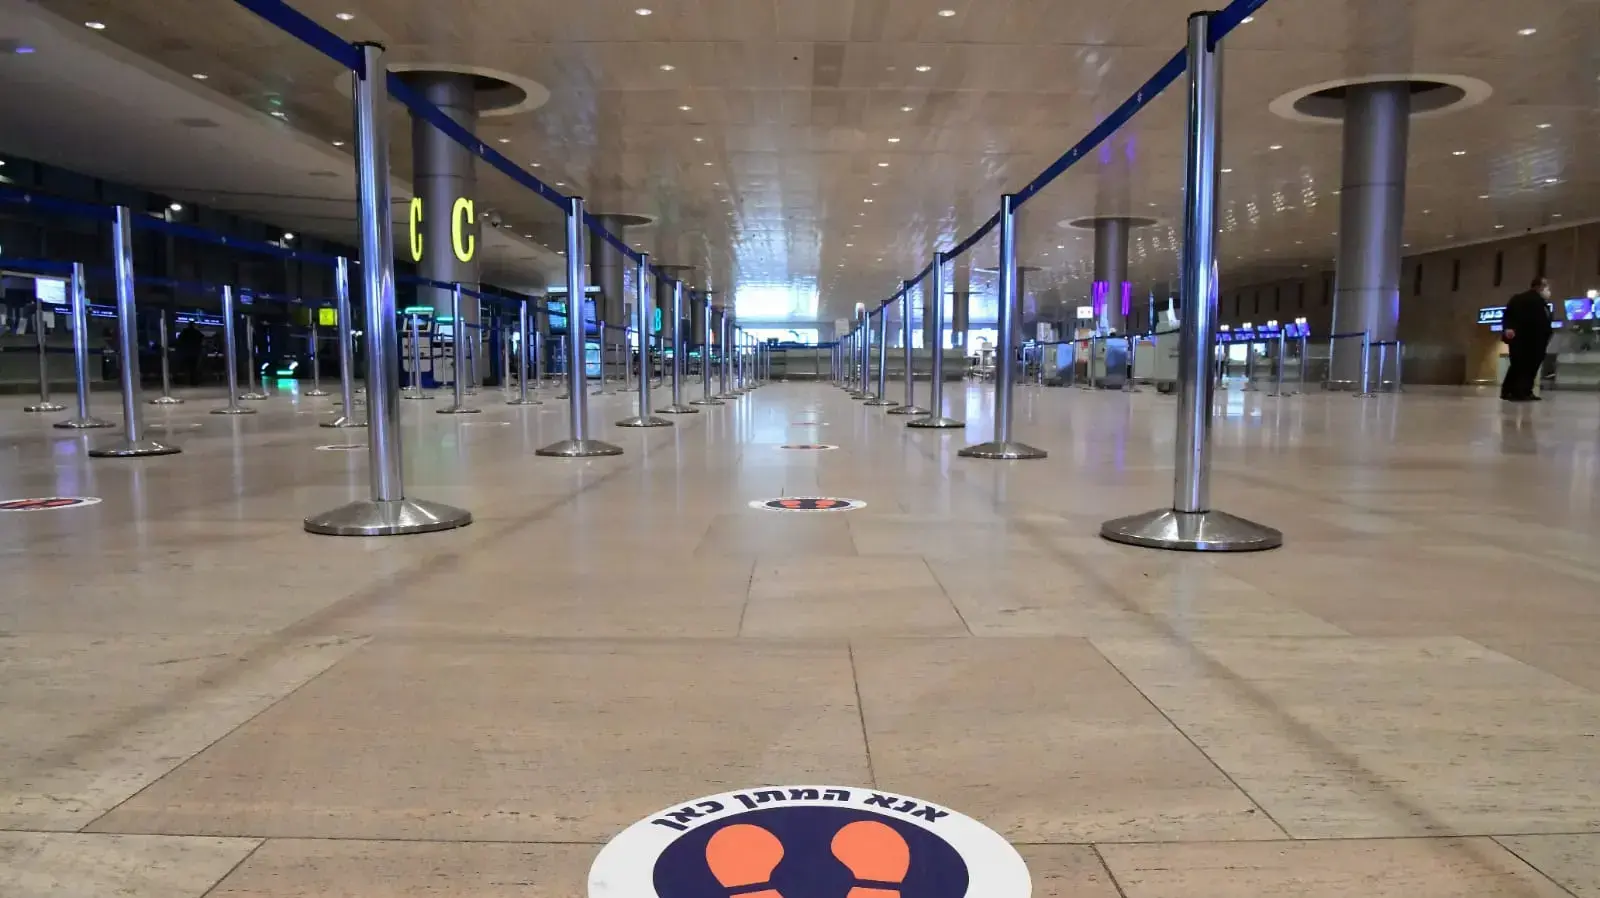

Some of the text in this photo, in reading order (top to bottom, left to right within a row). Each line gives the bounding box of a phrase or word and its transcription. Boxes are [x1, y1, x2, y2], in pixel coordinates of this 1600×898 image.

[409, 197, 422, 262] C
[451, 196, 475, 263] C
[651, 788, 950, 831] אנא המתן כאן
